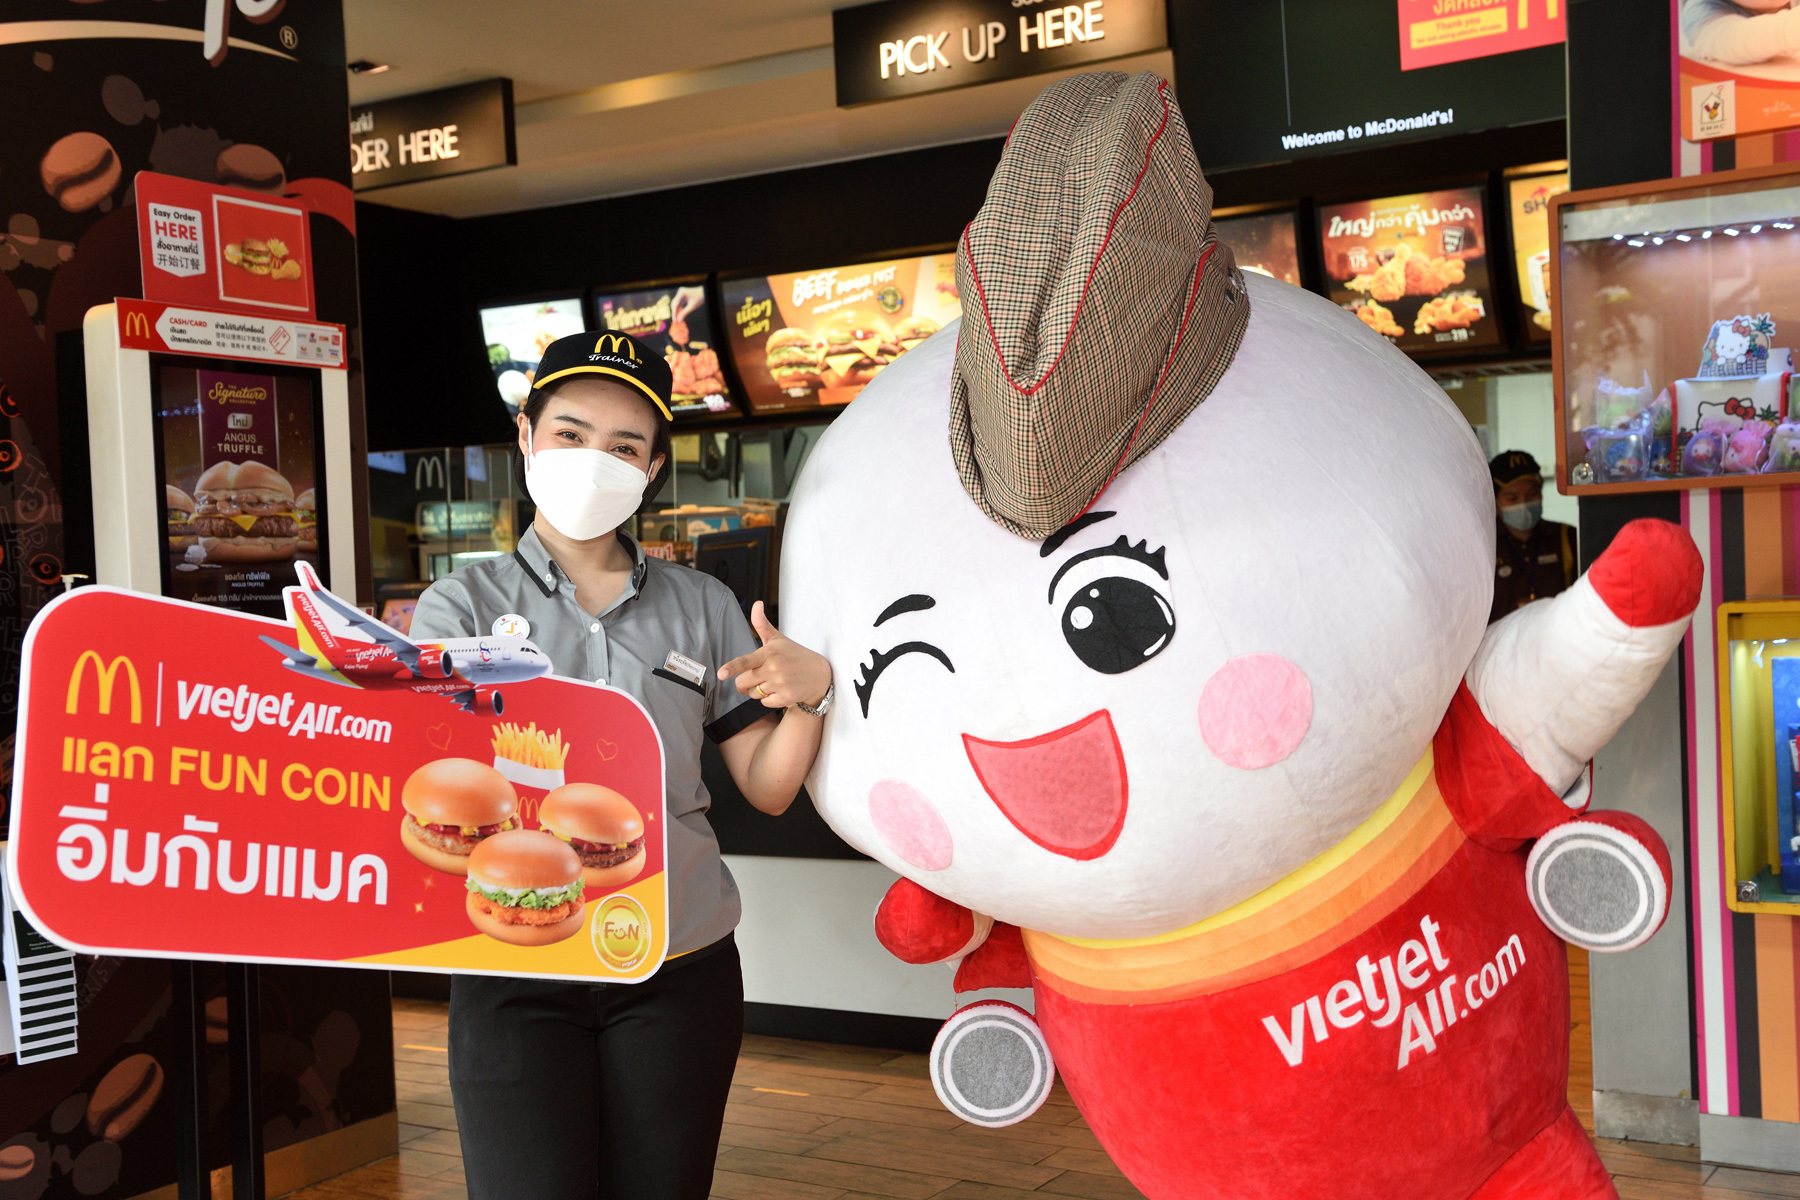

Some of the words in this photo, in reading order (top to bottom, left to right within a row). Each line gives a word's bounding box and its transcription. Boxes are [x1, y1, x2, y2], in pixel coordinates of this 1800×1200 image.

[1436, 20, 1462, 31] Thank
[1465, 17, 1481, 28] you
[879, 31, 950, 80] PICK
[962, 22, 1006, 62] UP
[1019, 1, 1105, 53] HERE
[1282, 126, 1345, 150] Welcome
[1347, 124, 1363, 140] to
[1365, 108, 1454, 137] McDonald's!
[397, 124, 460, 165] HERE
[153, 208, 171, 220] Easy
[173, 211, 196, 222] Order
[154, 220, 198, 241] HERE
[157, 253, 200, 271] 开始订餐
[792, 270, 839, 307] BEEF
[169, 317, 207, 328] CASH/CARD
[588, 353, 639, 370] Trainer
[208, 381, 267, 405] Signature
[231, 414, 248, 427] ใหม่
[224, 432, 256, 443] ANGUS
[217, 443, 263, 455] TRUFFLE
[62, 737, 154, 782] แลก
[170, 746, 267, 796] FUN
[281, 763, 391, 811] COIN
[56, 783, 389, 905] อิ่มกับแมค
[1397, 933, 1526, 1071] Air.com
